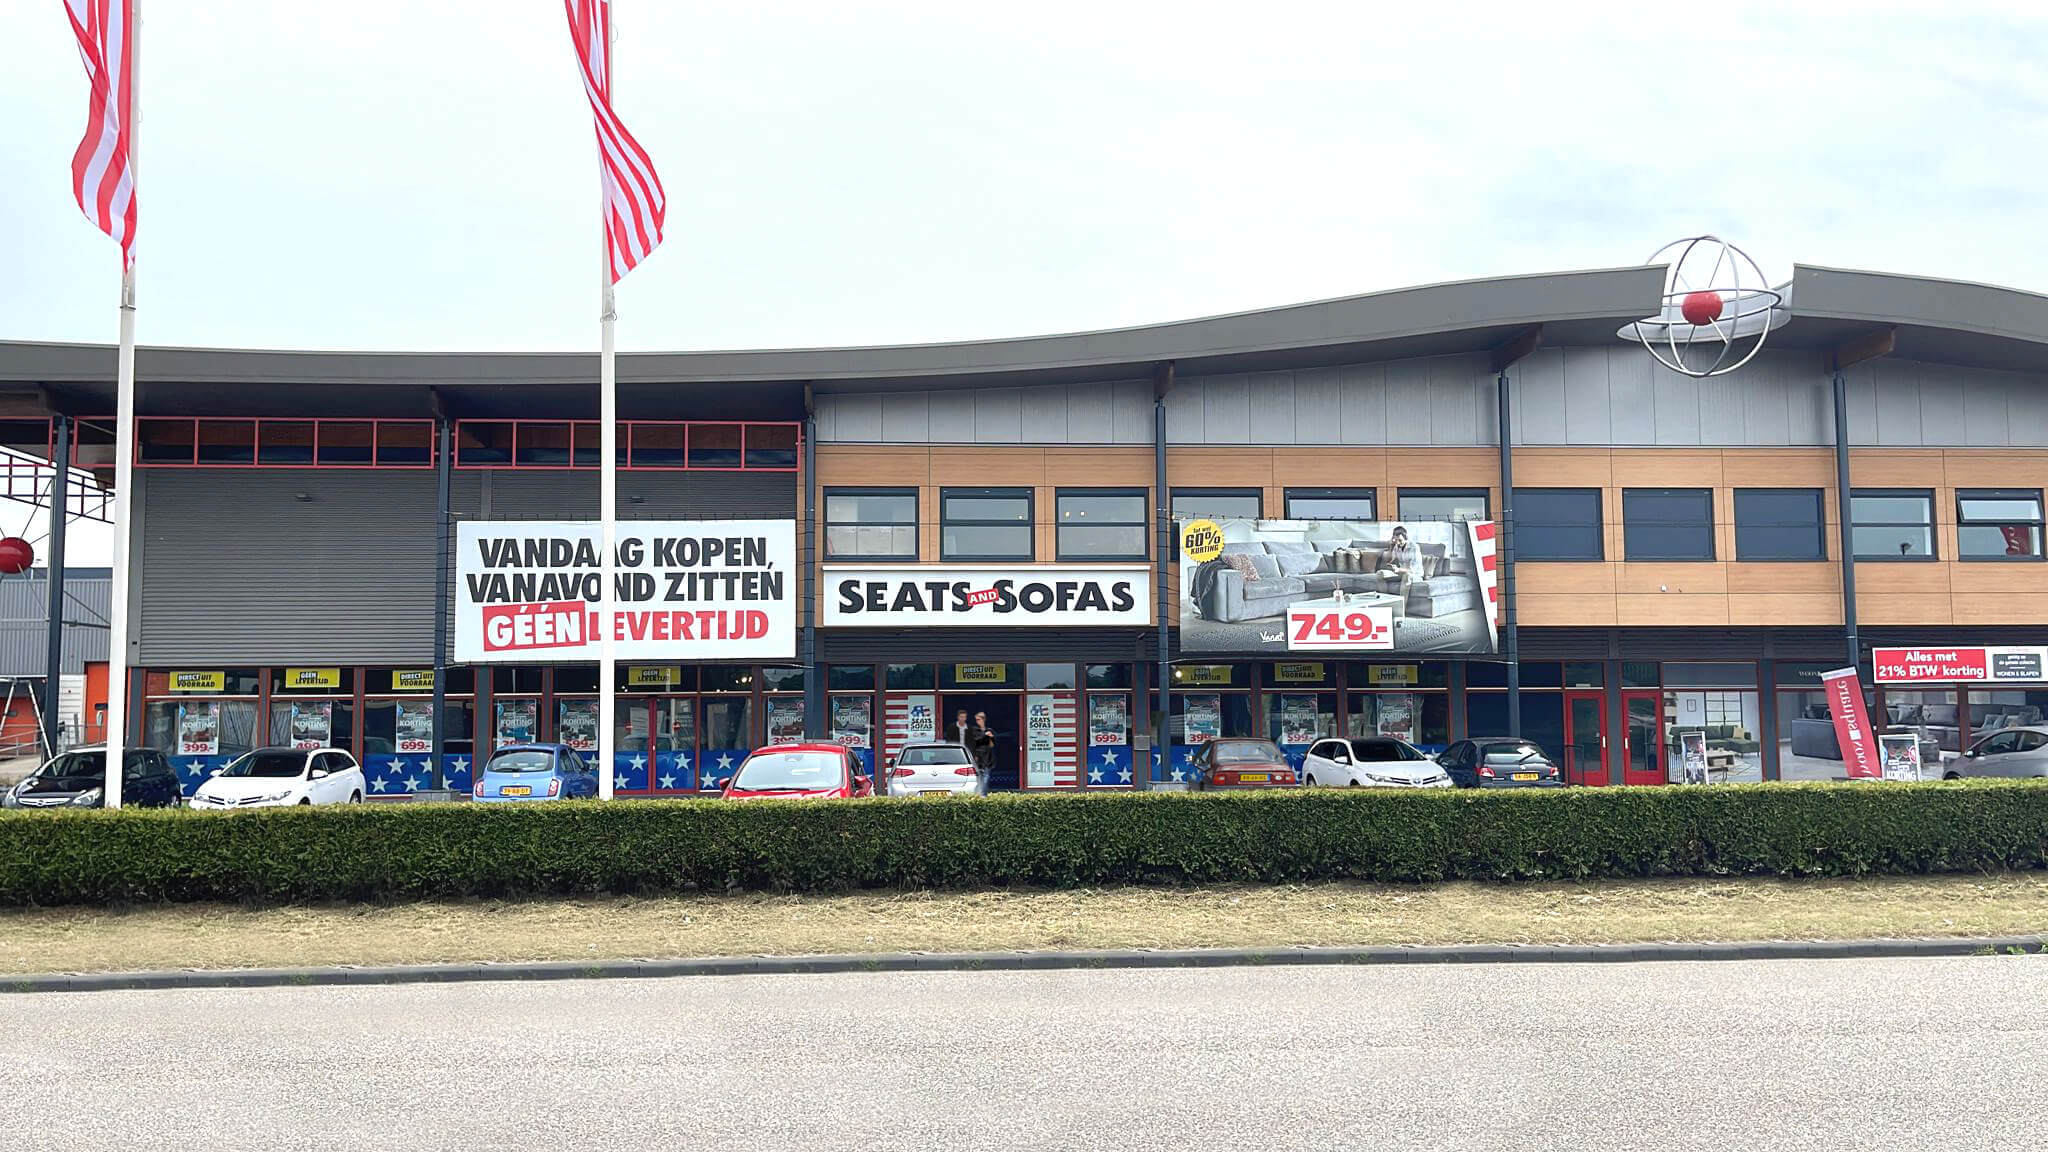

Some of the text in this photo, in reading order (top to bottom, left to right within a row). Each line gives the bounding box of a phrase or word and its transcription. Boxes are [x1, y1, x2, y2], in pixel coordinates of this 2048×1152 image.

[653, 537, 775, 569] KOPEN,
[1186, 530, 1221, 548] 60%
[466, 571, 784, 602] VANAVOND ZITTEN
[839, 579, 1135, 613] SEATS AND SOFAS
[487, 605, 769, 648] GÉÉN LEVERTIJD
[1291, 613, 1388, 641] 749.-
[1878, 664, 1985, 678] 21% BTW korting
[1905, 651, 1958, 662] Alles met
